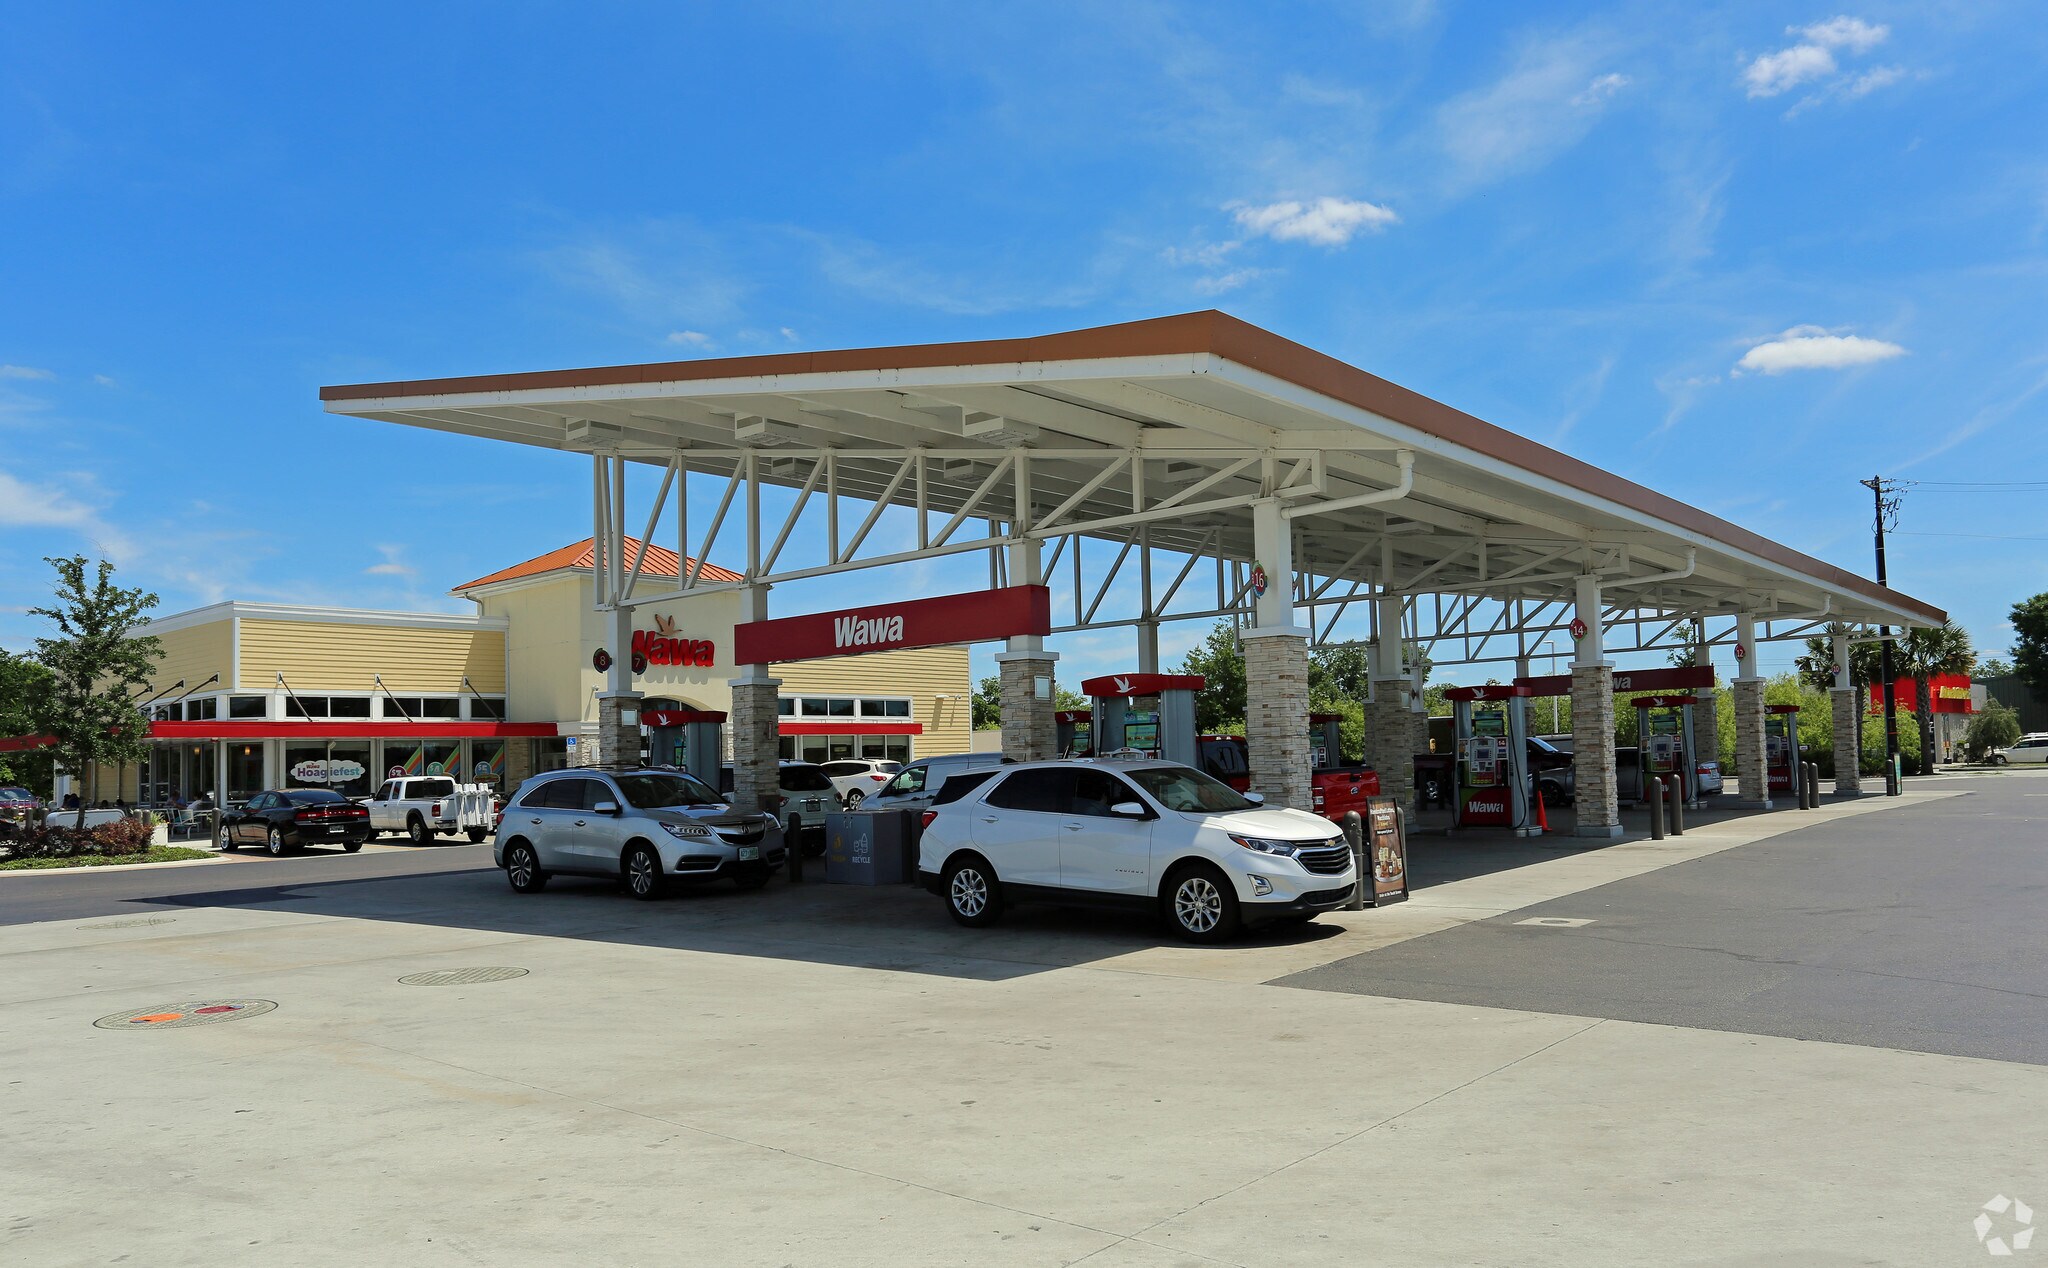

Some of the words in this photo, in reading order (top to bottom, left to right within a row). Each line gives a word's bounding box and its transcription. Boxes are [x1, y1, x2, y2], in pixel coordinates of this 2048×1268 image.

[1255, 572, 1264, 587] 16
[834, 615, 903, 648] Wawa
[1573, 625, 1584, 636] 14
[632, 630, 714, 667] Wawa
[1736, 649, 1744, 658] 12
[600, 655, 606, 666] 8
[635, 658, 640, 667] 7
[1612, 676, 1631, 689] wa
[297, 767, 360, 778] Hoagiefest
[1468, 801, 1504, 813] Wawa
